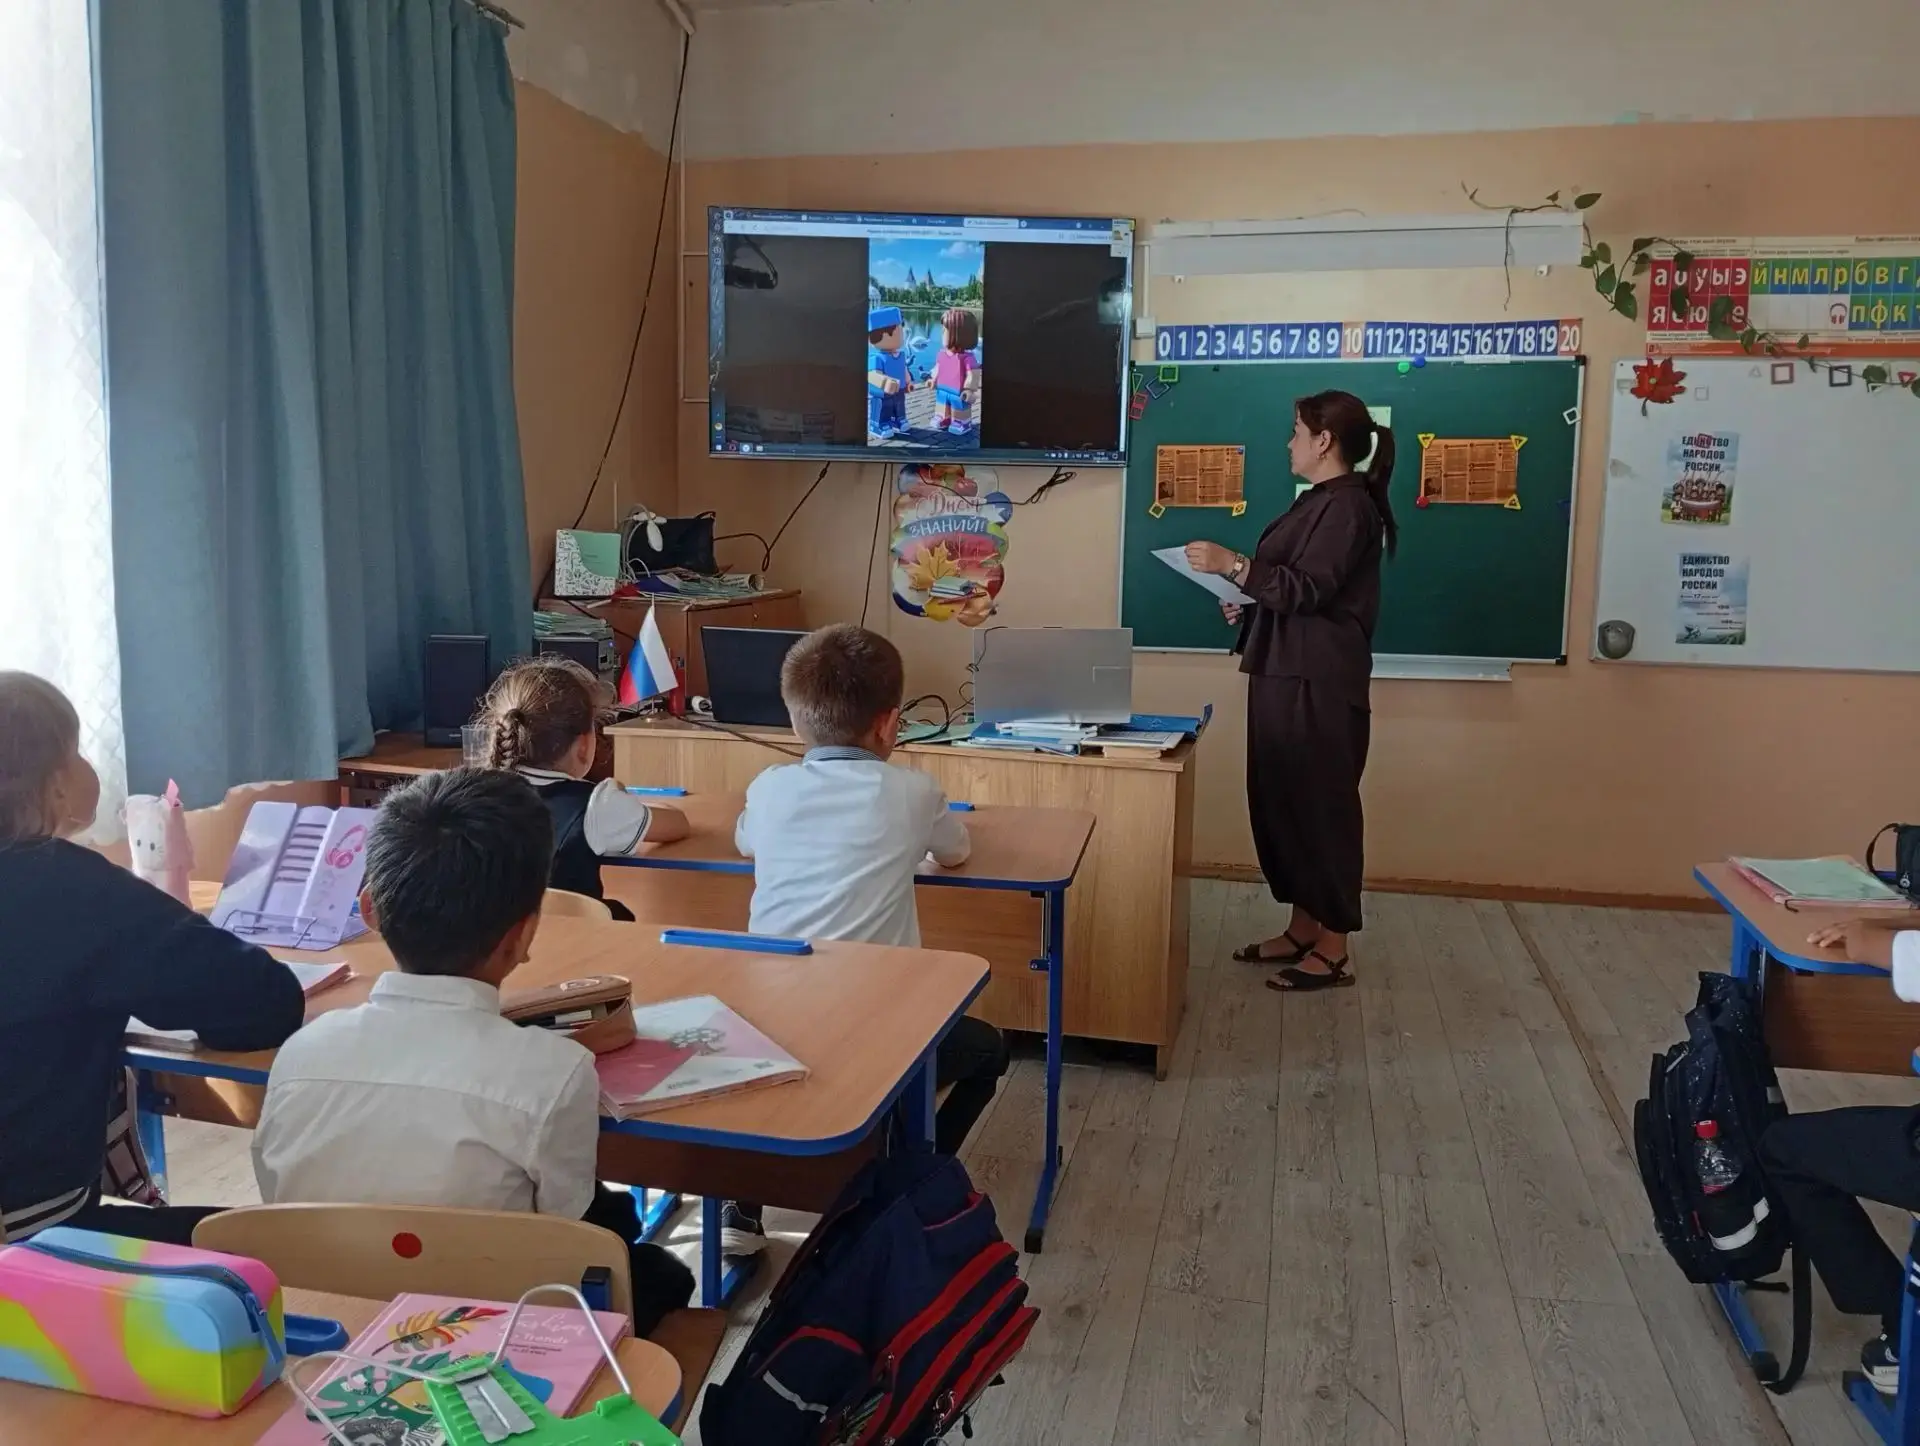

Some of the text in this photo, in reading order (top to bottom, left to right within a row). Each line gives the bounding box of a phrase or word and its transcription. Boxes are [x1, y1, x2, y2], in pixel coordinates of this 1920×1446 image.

[1654, 268, 1668, 286] а
[1695, 267, 1708, 292] у
[1712, 267, 1729, 285] ы
[1734, 267, 1747, 285] э
[1753, 261, 1768, 285] й
[1774, 267, 1787, 285] н
[1791, 267, 1809, 285] м
[1813, 266, 1828, 285] л
[1833, 265, 1848, 292] р
[1854, 260, 1868, 286] б
[1875, 265, 1889, 285] в
[1897, 265, 1909, 284] г
[1652, 305, 1666, 324] я
[1689, 305, 1707, 323] ю
[1731, 305, 1745, 323] е
[1851, 304, 1866, 323] п
[1870, 299, 1889, 329] ф
[1893, 304, 1906, 323] к
[1158, 324, 1580, 357] 0 1 2 3 4 5 6 7 8 9 10 11 12 13 14 15 16 17 18 19 20
[1683, 449, 1725, 460] НАРОДОВ
[1685, 462, 1721, 472] РОССИИ
[1682, 555, 1730, 566] ЕДИНСТВО
[1682, 568, 1725, 578] НАРОДОВ
[1681, 580, 1718, 590] РОССИИ
